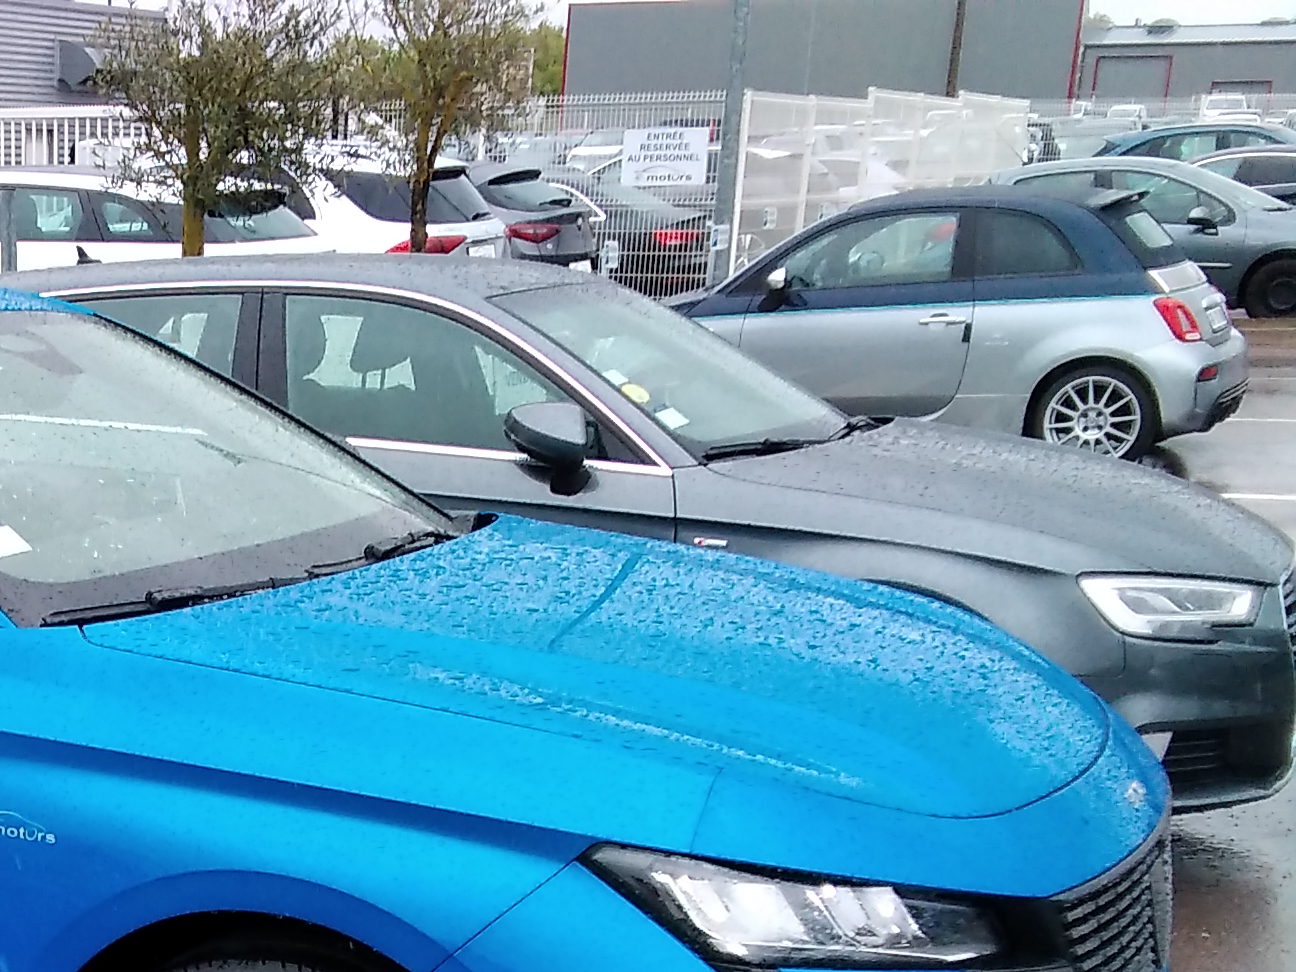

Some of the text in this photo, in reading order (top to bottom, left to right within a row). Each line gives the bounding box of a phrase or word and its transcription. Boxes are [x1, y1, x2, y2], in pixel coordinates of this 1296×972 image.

[646, 131, 684, 141] ENTRÉE
[627, 152, 701, 163] AU PERSONNEL
